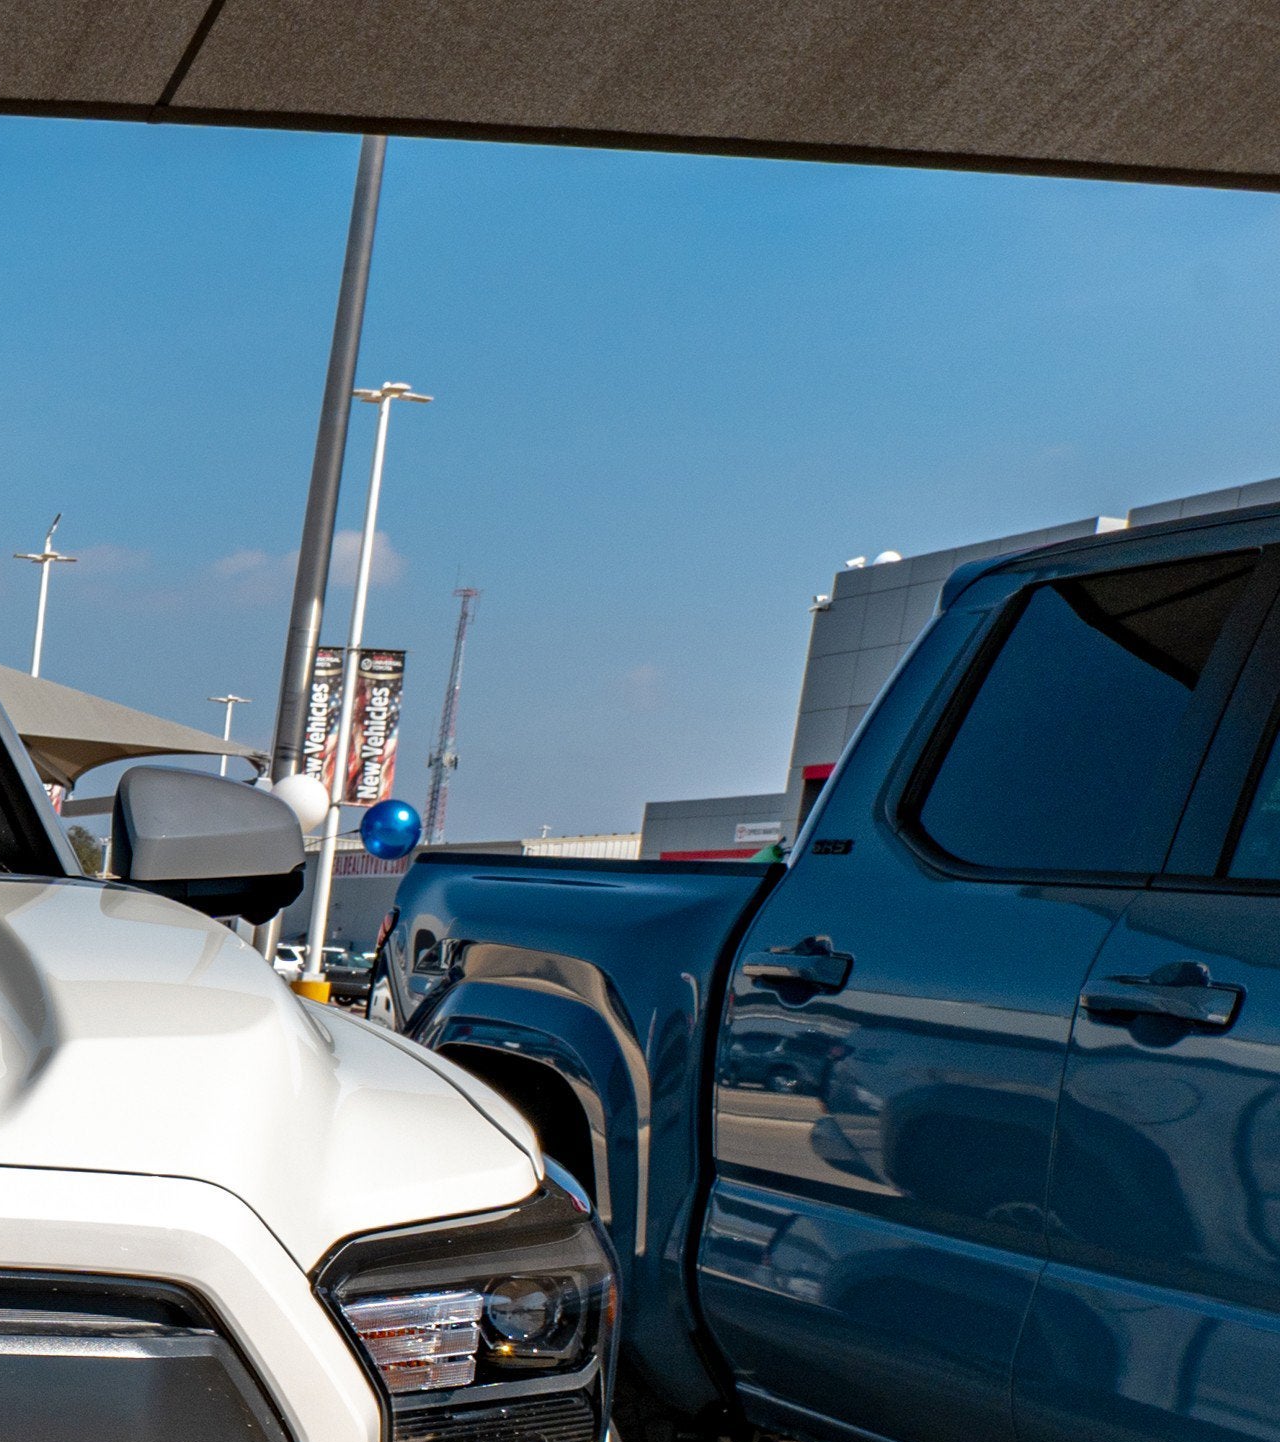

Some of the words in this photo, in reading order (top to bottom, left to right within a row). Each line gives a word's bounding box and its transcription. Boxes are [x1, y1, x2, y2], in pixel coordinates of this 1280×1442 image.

[304, 683, 330, 755] Vehicles
[362, 687, 391, 759] Vehicles
[357, 761, 382, 799] New
